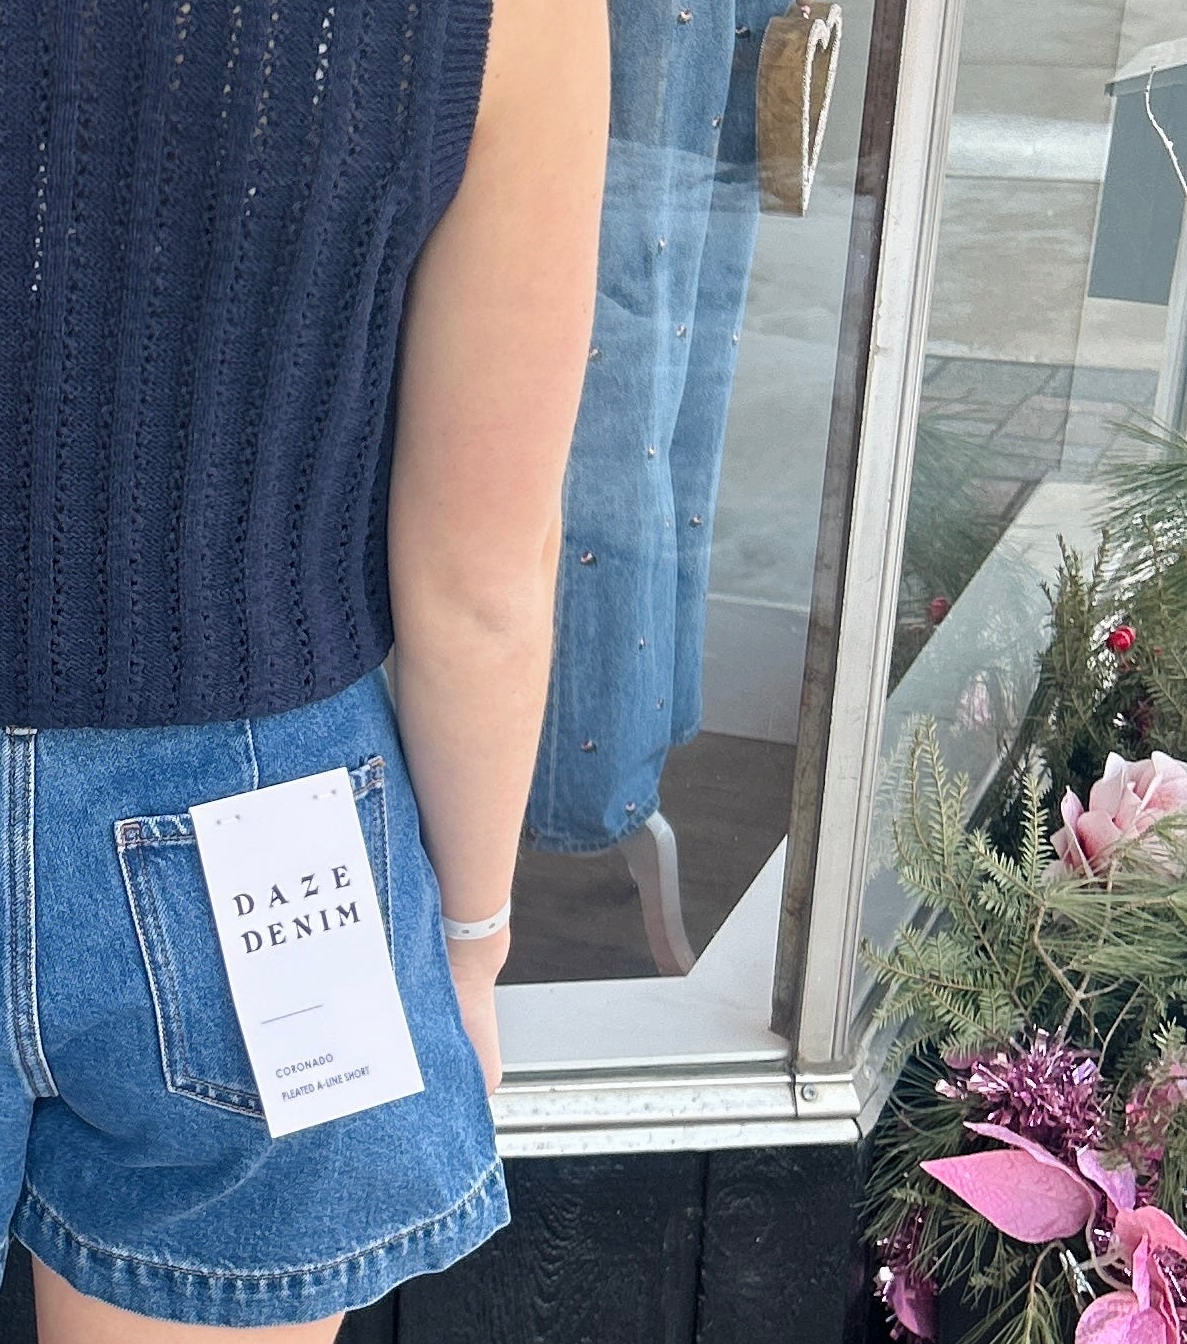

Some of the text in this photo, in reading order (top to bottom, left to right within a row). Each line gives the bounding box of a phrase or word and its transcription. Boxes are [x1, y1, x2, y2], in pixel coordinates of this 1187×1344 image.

[231, 864, 352, 917] DAZE
[240, 901, 362, 954] DENIM
[275, 1053, 334, 1079] CORONADO
[281, 1065, 371, 1102] PLEATED A-LINE SHORT
